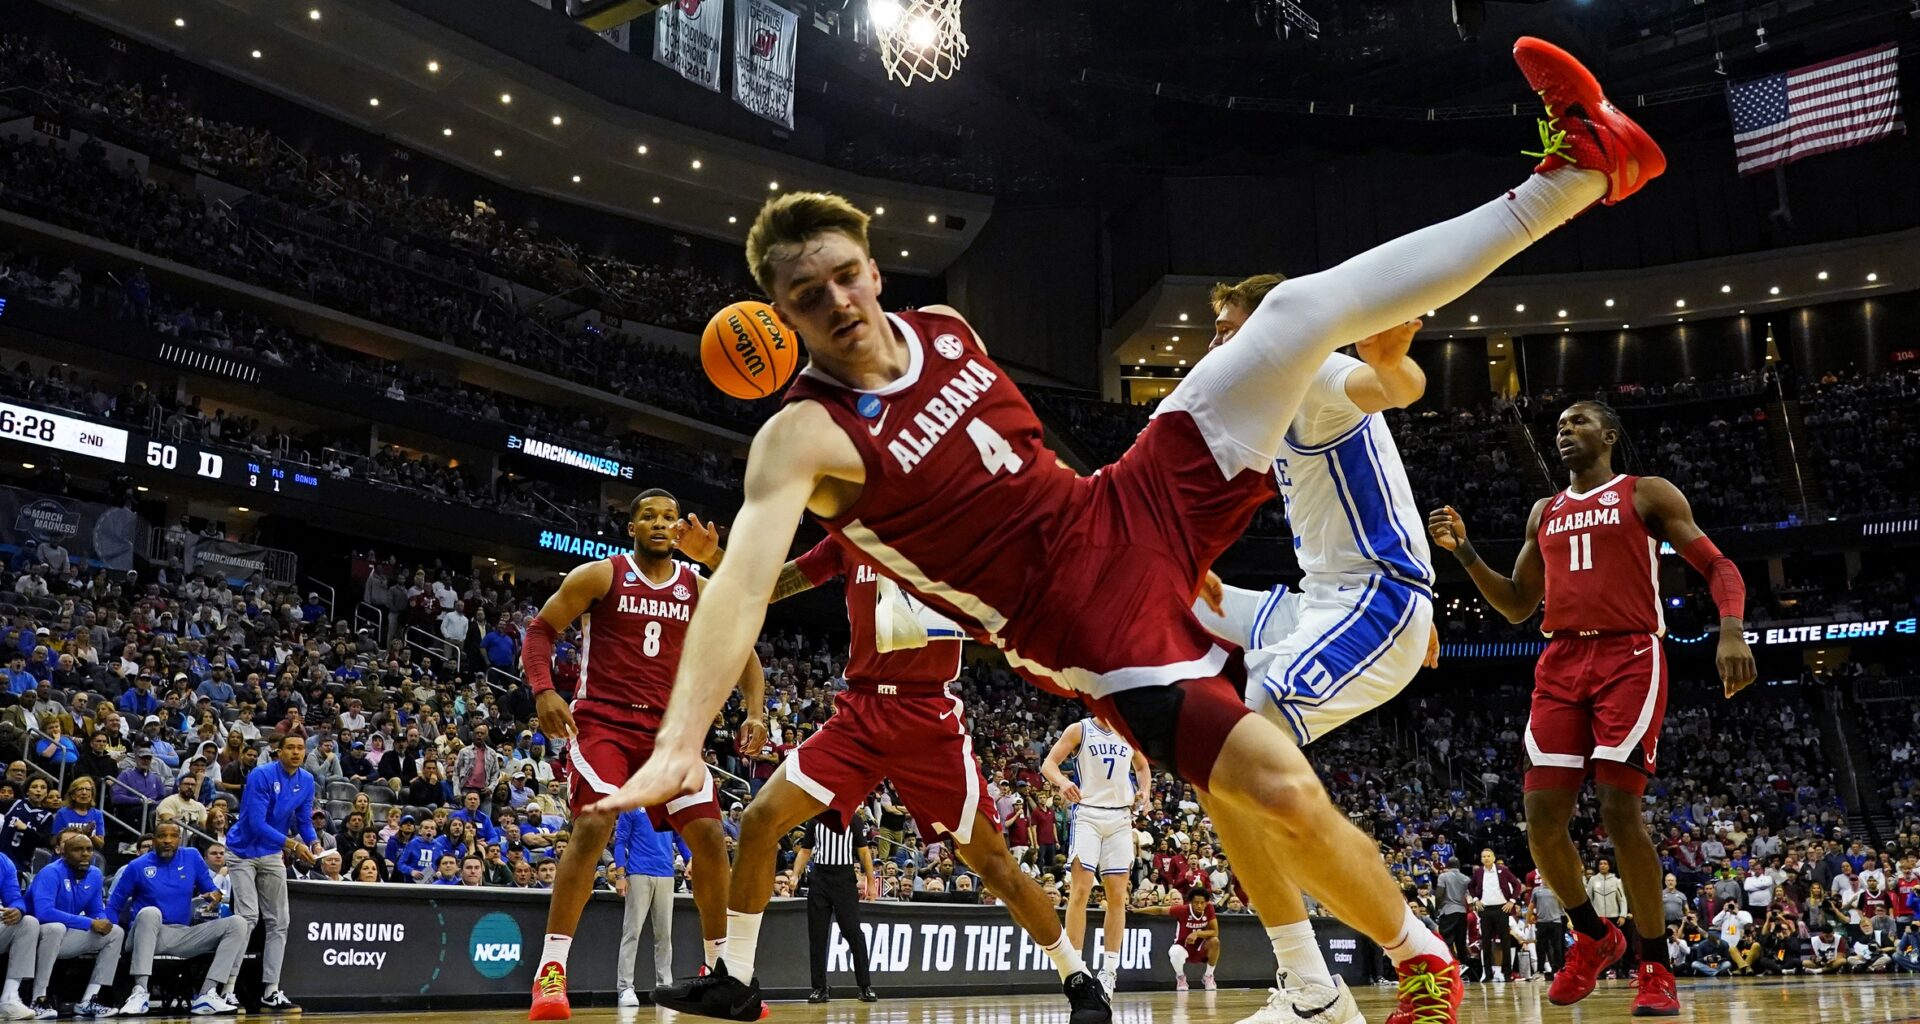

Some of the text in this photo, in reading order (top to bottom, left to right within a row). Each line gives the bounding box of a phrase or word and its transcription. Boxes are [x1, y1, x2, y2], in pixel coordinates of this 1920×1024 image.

[750, 6, 782, 31] DEVILS
[690, 27, 719, 53] DIVISION
[42, 121, 60, 136] 111
[755, 310, 786, 350] NCAA
[728, 315, 766, 377] Wilson
[1897, 351, 1914, 360] 104
[888, 359, 998, 474] ALABAMA
[79, 432, 103, 447] 2ND
[965, 417, 1024, 476] 4
[146, 441, 177, 470] 50
[523, 438, 620, 476] MARCHMADNESS
[248, 463, 260, 474] TOL
[295, 474, 318, 486] BONUS
[250, 475, 280, 492] 3 1
[31, 509, 63, 522] MARCH
[34, 519, 76, 534] MADNESS
[1546, 508, 1620, 536] ALABAMA
[197, 551, 265, 570] #MARCHMADNESS
[1569, 533, 1593, 572] 11
[617, 595, 690, 622] ALABAMA
[643, 620, 662, 657] 8
[1766, 620, 1890, 645] ELITE EIGHT
[877, 684, 897, 695] RTR
[1088, 744, 1128, 757] DUKE
[1103, 758, 1115, 780] 7
[11, 832, 24, 847] 5
[307, 922, 405, 942] SAMSUNG
[474, 943, 521, 962] NCAA
[920, 924, 957, 972] TO
[964, 925, 1015, 971] THE
[1329, 939, 1356, 949] SAMSUNG
[323, 948, 386, 970] Galaxy
[1334, 953, 1352, 964] Galaxy
